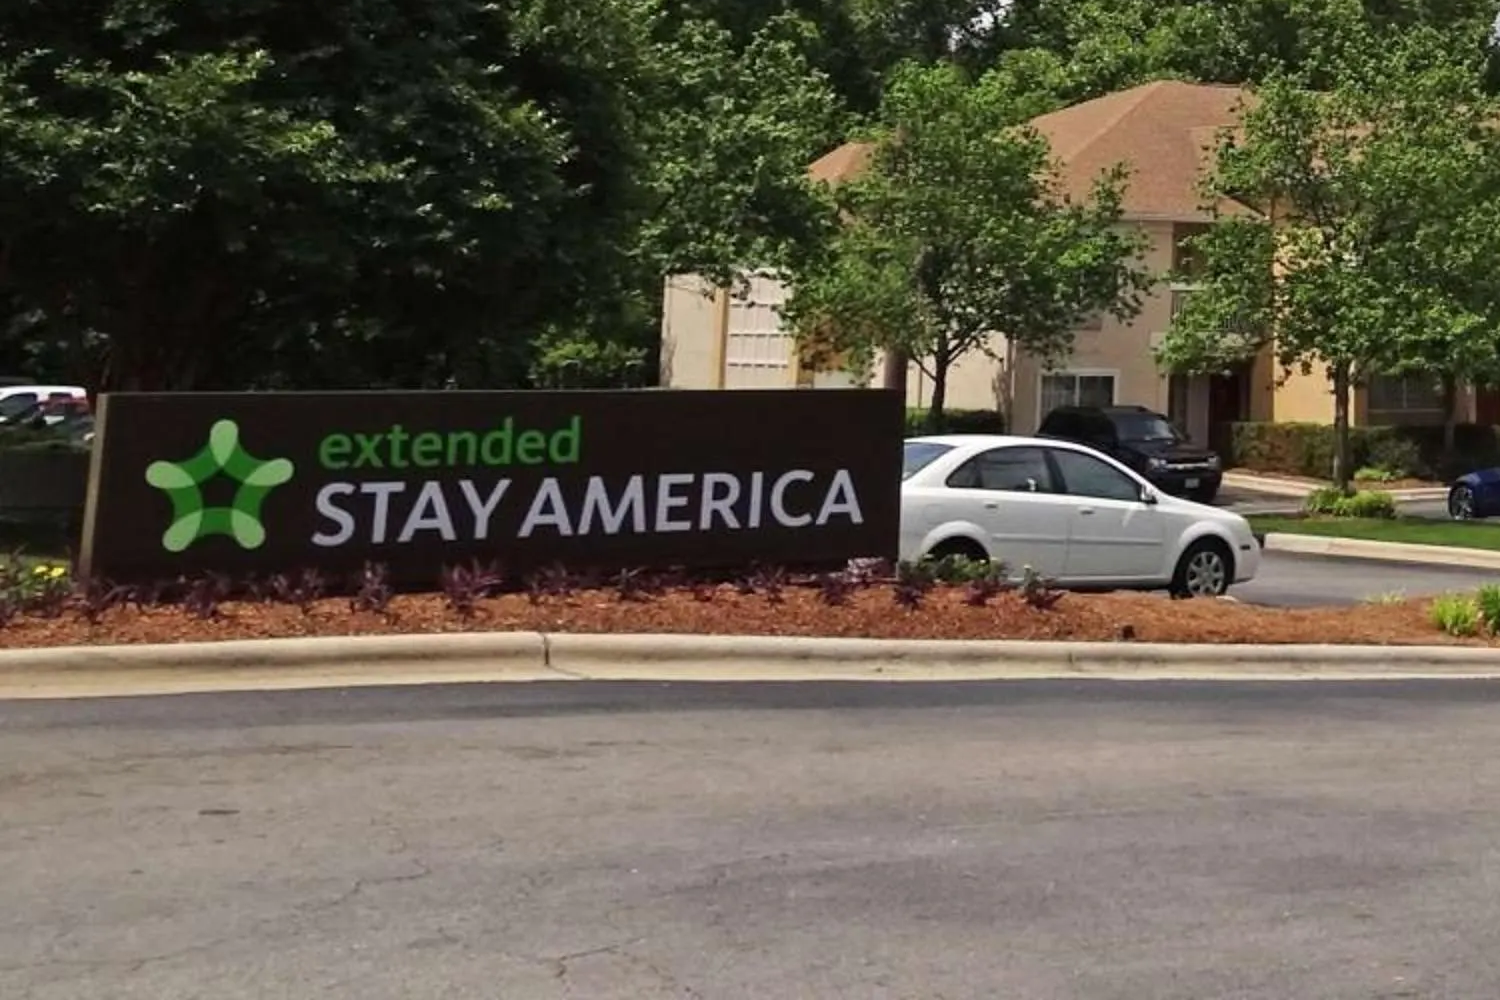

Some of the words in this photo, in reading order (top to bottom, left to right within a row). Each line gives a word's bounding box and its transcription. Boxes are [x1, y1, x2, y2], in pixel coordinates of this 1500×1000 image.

[319, 417, 580, 469] extended
[311, 480, 510, 546] STAY
[520, 469, 864, 535] AMERICA
